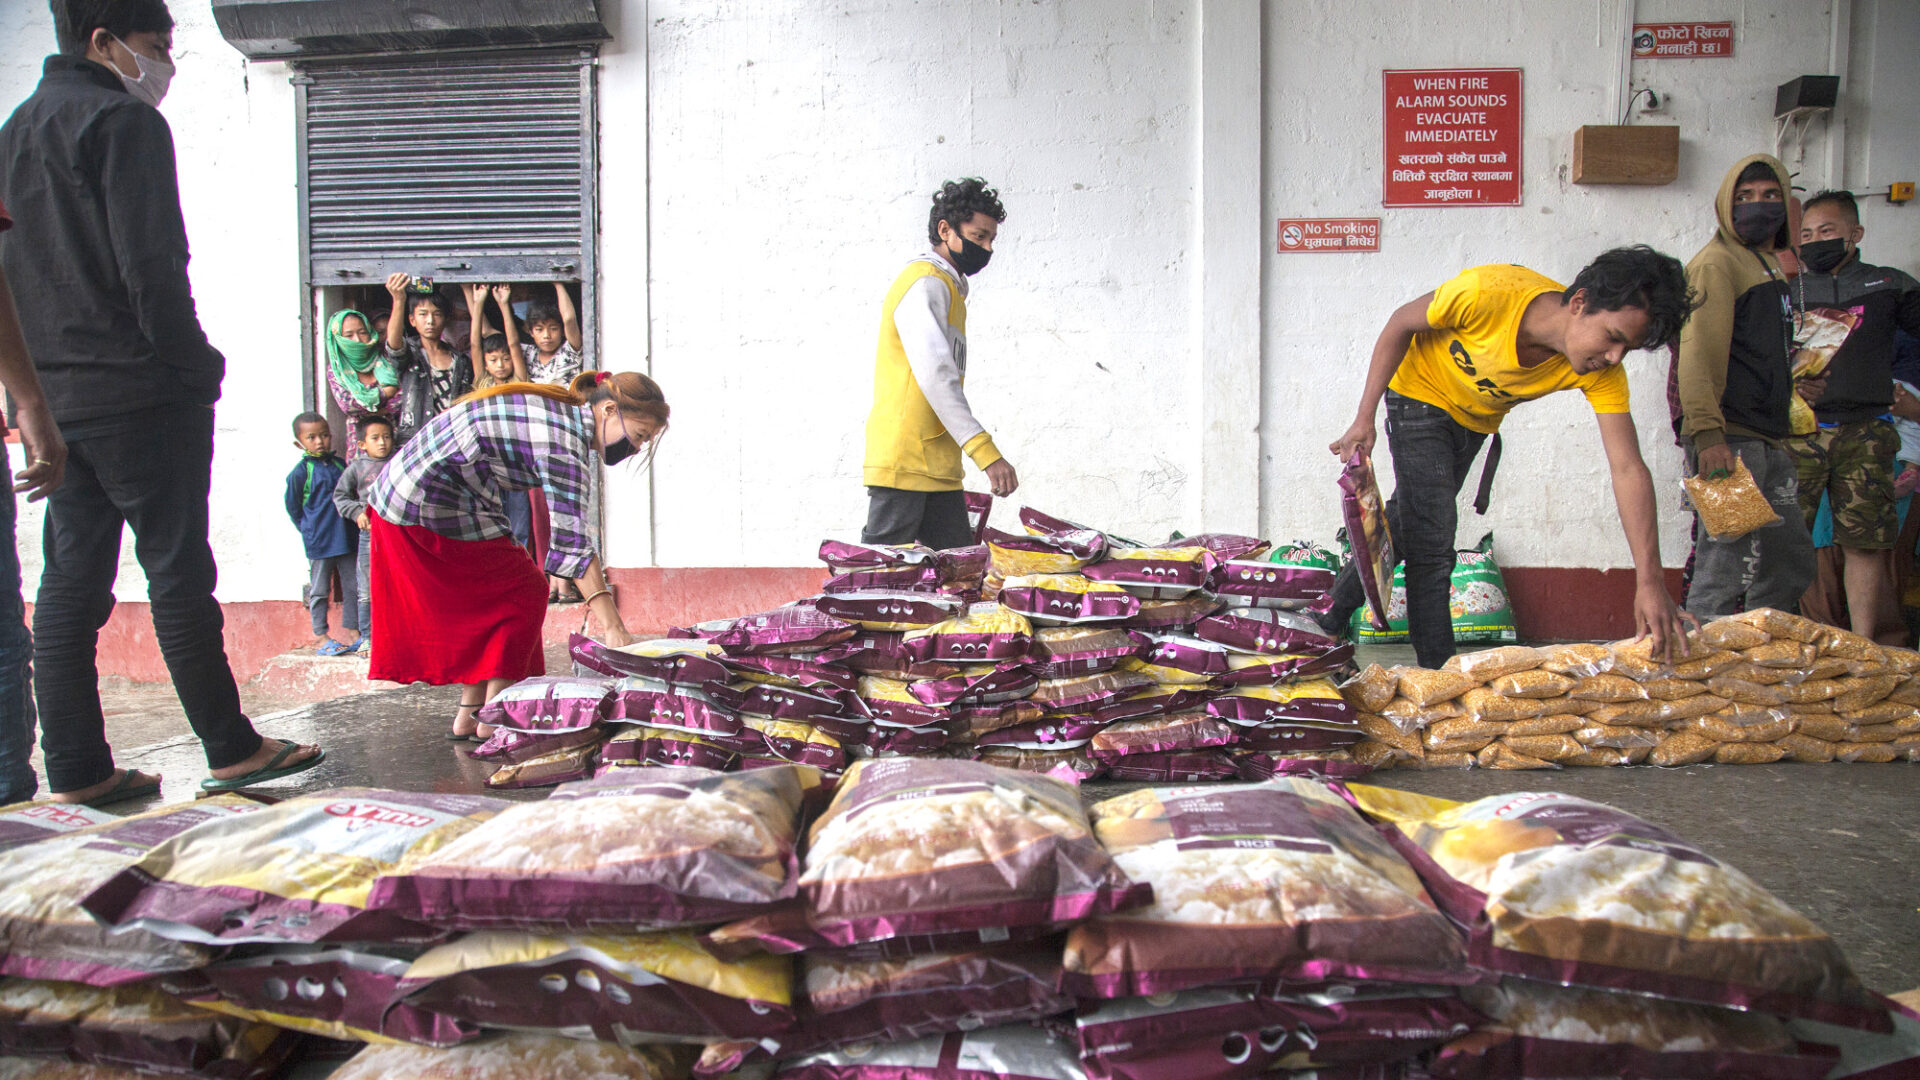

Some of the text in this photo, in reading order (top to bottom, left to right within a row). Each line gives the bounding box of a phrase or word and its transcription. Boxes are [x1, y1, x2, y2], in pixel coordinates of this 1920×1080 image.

[1657, 26, 1690, 39] फोटो
[1656, 41, 1698, 55] मनाही
[1413, 77, 1489, 91] WHEN FIRE
[1395, 94, 1507, 108] ALARM SOUNDS
[1416, 112, 1487, 125] EVACUATE
[1405, 129, 1498, 143] IMMEDIATELY
[1398, 151, 1507, 165] खतराको संकेत पाउने
[1429, 169, 1469, 184] सुरक्षित
[1471, 170, 1513, 182] स्थानमा
[1423, 186, 1473, 201] जानुहोला
[1305, 222, 1377, 237] No Smoking
[896, 789, 936, 800] RICE
[1234, 839, 1275, 848] RICE
